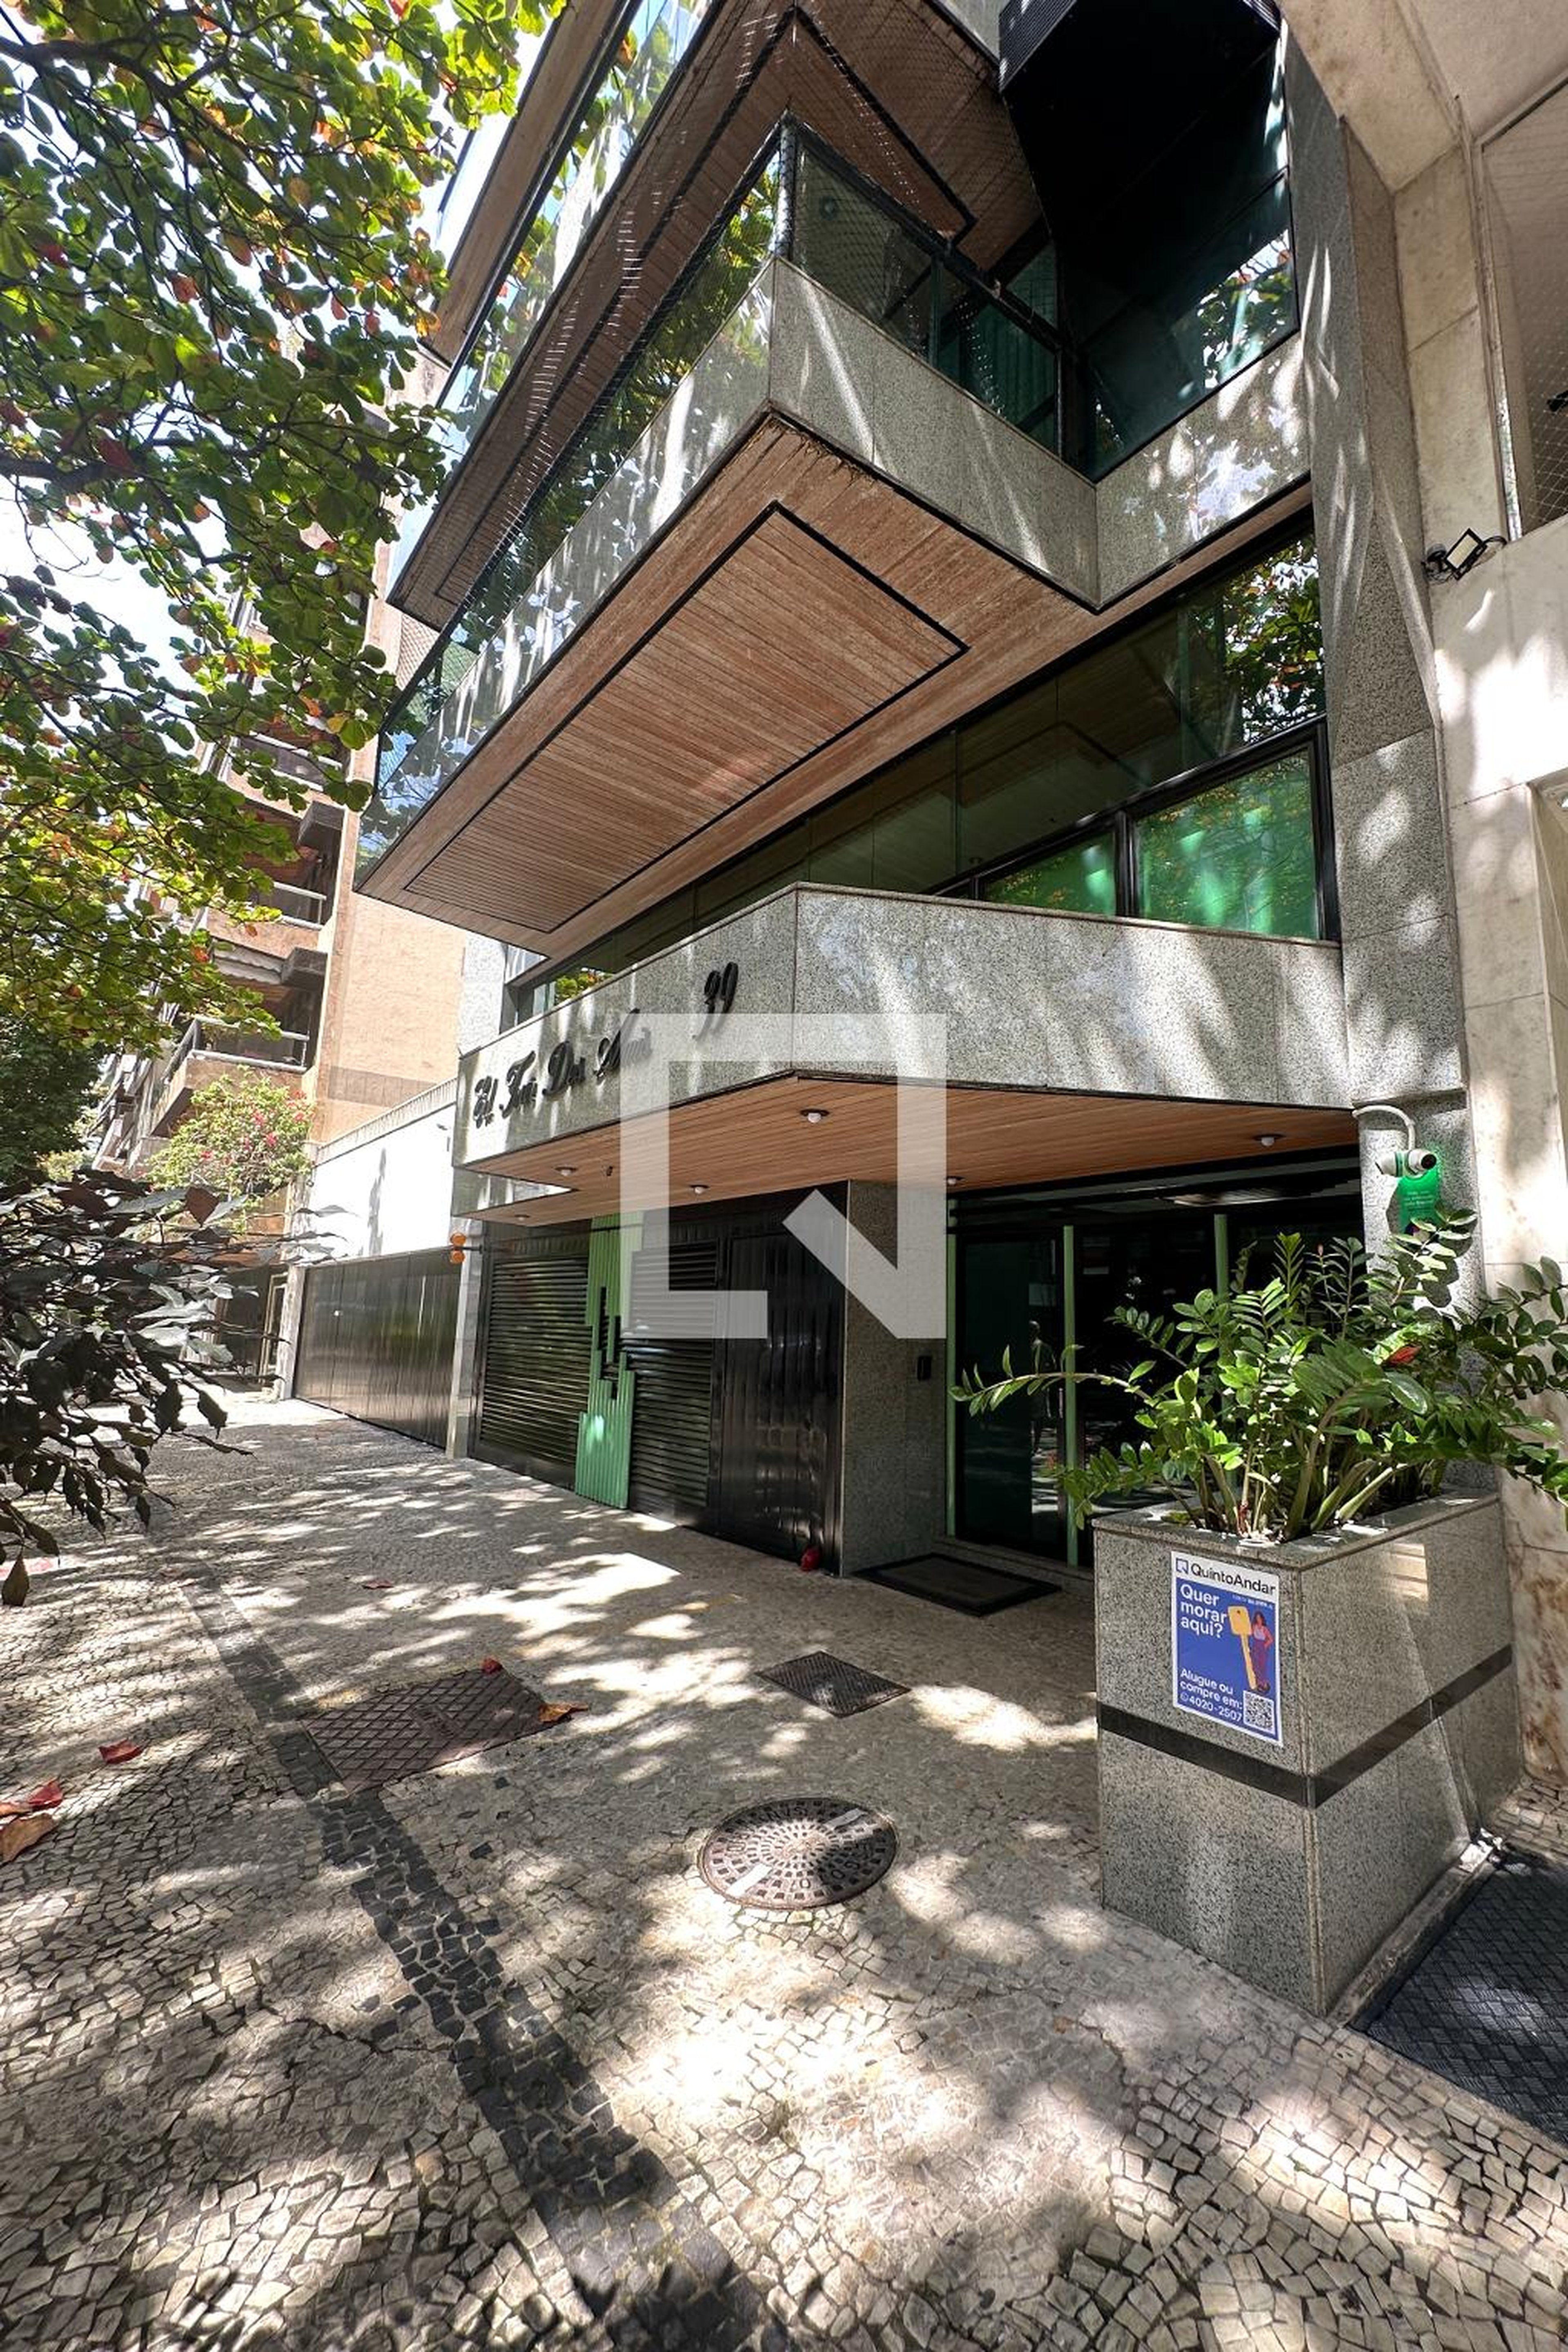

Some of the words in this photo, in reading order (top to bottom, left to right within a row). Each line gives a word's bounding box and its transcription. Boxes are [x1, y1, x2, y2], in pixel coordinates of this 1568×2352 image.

[1191, 1563, 1276, 1594] QuintoAndar
[1180, 1584, 1219, 1606] Quer
[1180, 1601, 1227, 1624] morar
[1181, 1617, 1223, 1638] aqui?
[1180, 1668, 1217, 1689] Alugue
[1219, 1684, 1233, 1695] ou
[1180, 1681, 1221, 1702] compre
[1222, 1696, 1243, 1710] em:
